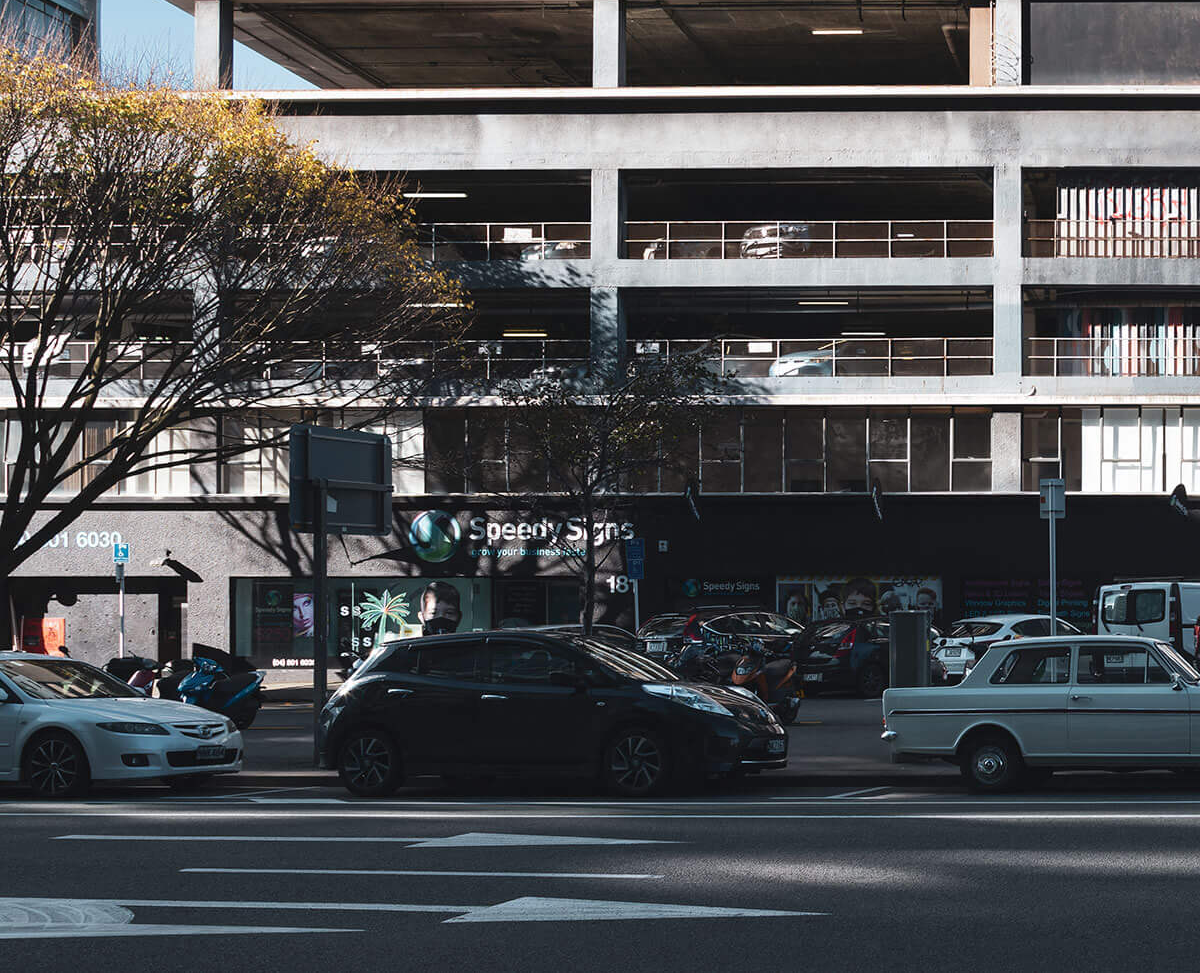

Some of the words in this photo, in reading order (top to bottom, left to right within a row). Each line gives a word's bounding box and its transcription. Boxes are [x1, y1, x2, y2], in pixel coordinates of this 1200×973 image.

[468, 516, 563, 546] Speedy
[565, 515, 635, 547] Signs
[76, 530, 122, 548] 6030
[471, 547, 495, 558] grow
[495, 548, 518, 558] your
[519, 546, 561, 557] business
[703, 581, 736, 592] Speedy
[736, 581, 760, 592] Signs
